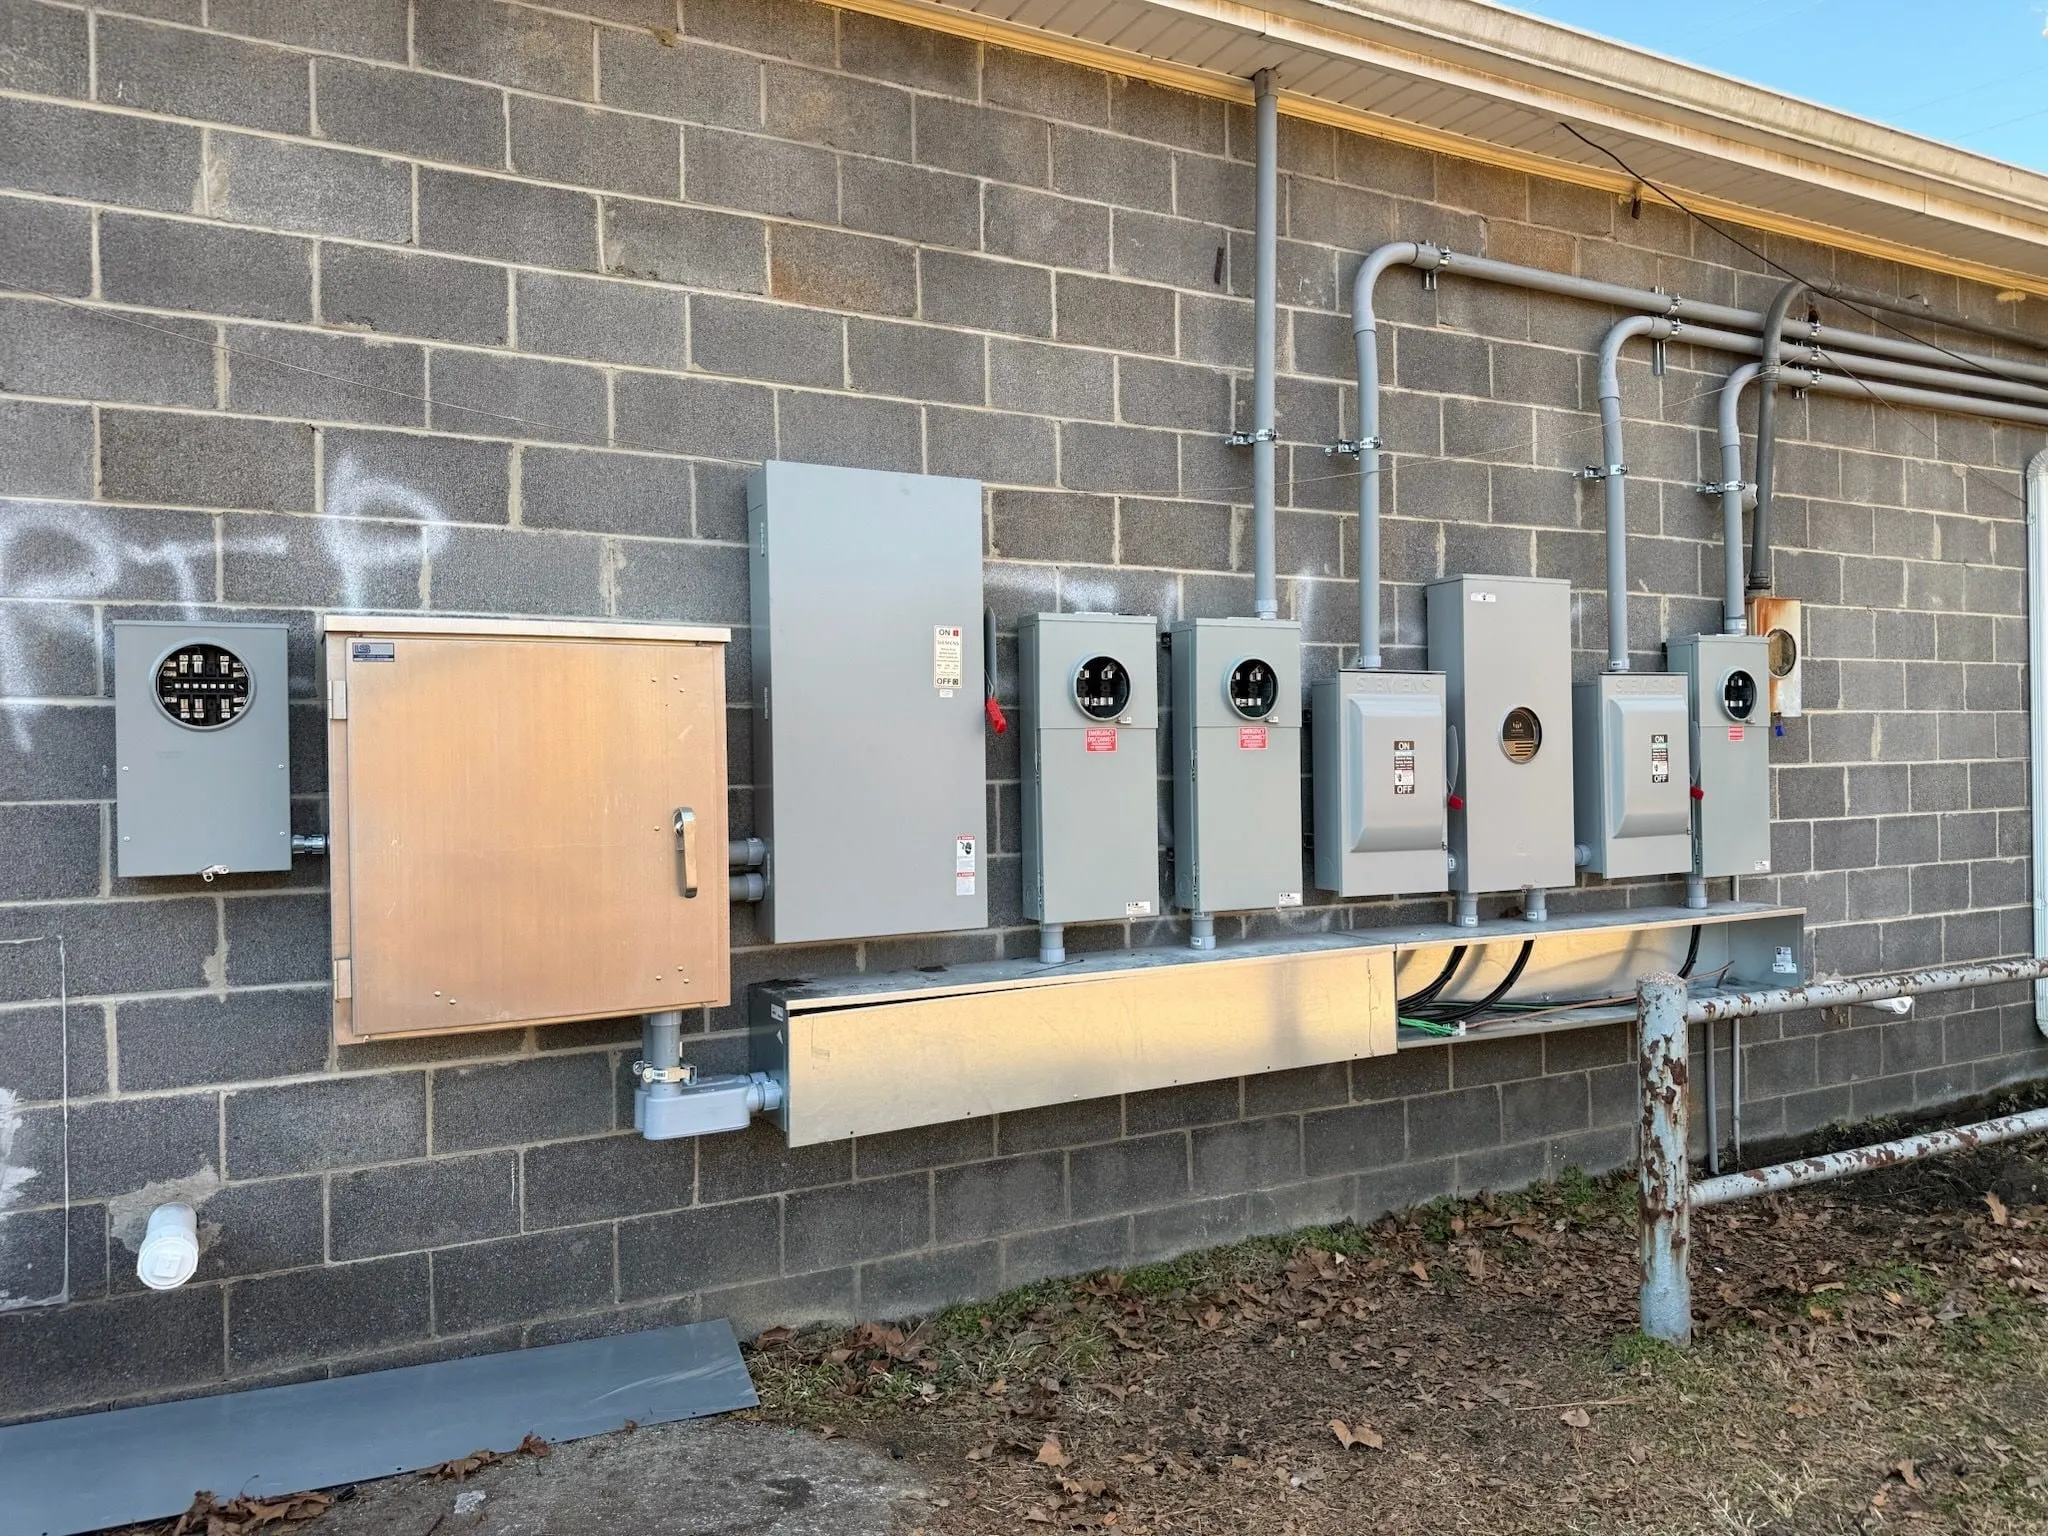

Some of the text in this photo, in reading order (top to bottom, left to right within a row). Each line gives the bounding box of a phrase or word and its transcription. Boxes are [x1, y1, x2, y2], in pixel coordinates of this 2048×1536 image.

[936, 677, 952, 685] OFF
[1356, 675, 1432, 692] SIEMENS
[1615, 677, 1677, 693] SIEMENS
[1398, 742, 1410, 750] ON
[1654, 775, 1667, 783] OFF
[1397, 785, 1412, 794] OFF
